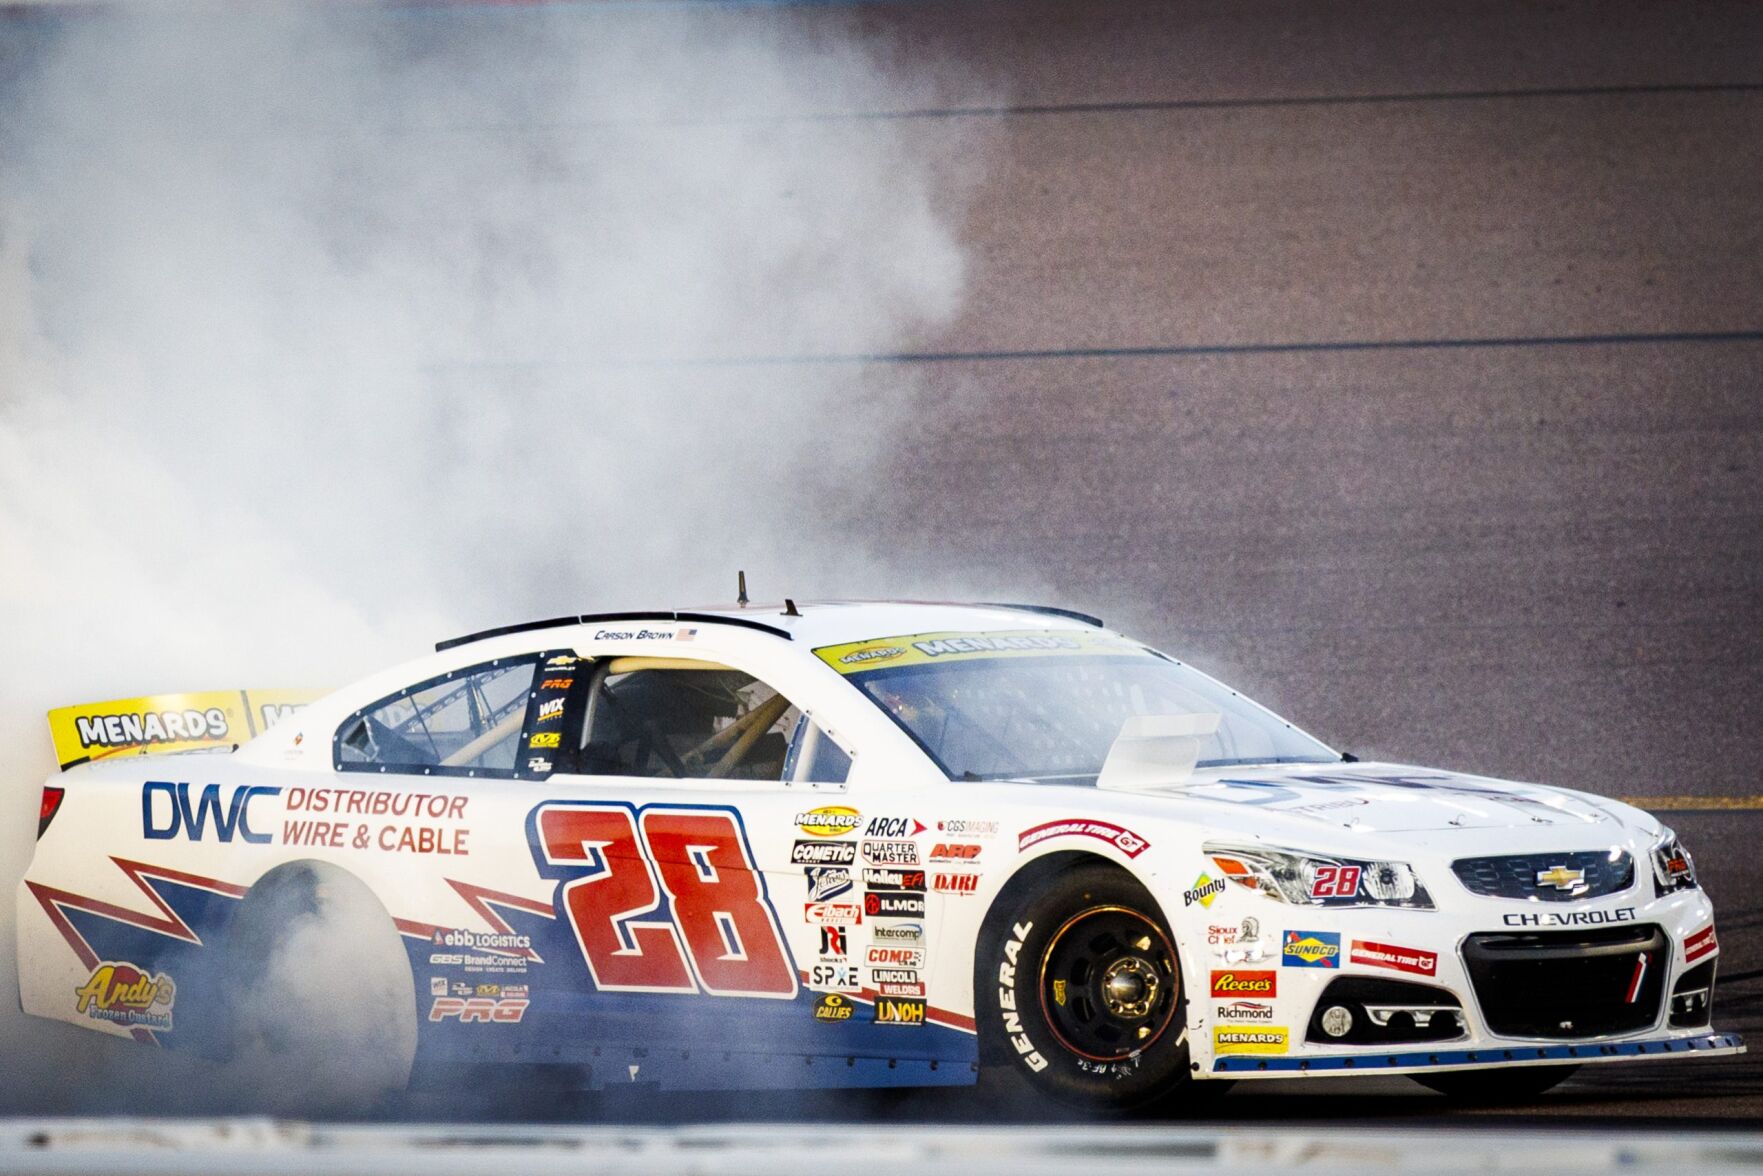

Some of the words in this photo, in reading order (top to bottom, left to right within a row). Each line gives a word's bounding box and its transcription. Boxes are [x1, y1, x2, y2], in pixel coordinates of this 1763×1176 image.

[912, 636, 1082, 657] MENARDS
[539, 697, 566, 717] WIX
[76, 709, 228, 749] MENARDS
[142, 781, 283, 844] DWC
[286, 787, 469, 819] DISTRIBUTOR
[794, 812, 864, 829] MENARDS
[864, 817, 908, 837] ARCA
[282, 820, 349, 848] WIRE
[351, 823, 371, 850] &
[378, 825, 470, 856] CABLE
[863, 841, 915, 855] QUARTER
[793, 843, 856, 861] COMETIC
[872, 851, 918, 863] MASTER
[929, 844, 982, 860] ARP
[863, 869, 904, 889] Holley
[1311, 866, 1363, 898] 28
[526, 800, 799, 1000] 28
[1183, 877, 1226, 907] Bounty
[806, 904, 860, 922] Eibach
[1503, 907, 1636, 926] CHEVROLET
[444, 929, 475, 947] ebb
[475, 933, 531, 949] LOGISTICS
[874, 928, 922, 943] Intercomp
[868, 949, 914, 963] COMP
[1286, 943, 1338, 956] SUNOCO
[1351, 948, 1397, 962] GENERAL
[465, 954, 528, 967] BrandConnect
[76, 965, 174, 1015] Andy's
[1214, 973, 1271, 991] Reese's
[999, 920, 1049, 1072] GENERAL
[89, 1003, 127, 1020] Frozen
[128, 1009, 172, 1029] Custard
[429, 997, 531, 1022] PRG
[816, 1005, 852, 1020] CALLIES
[878, 1000, 924, 1022] UNOH
[1217, 1005, 1272, 1019] Richmond
[1218, 1033, 1284, 1045] MENARDS
